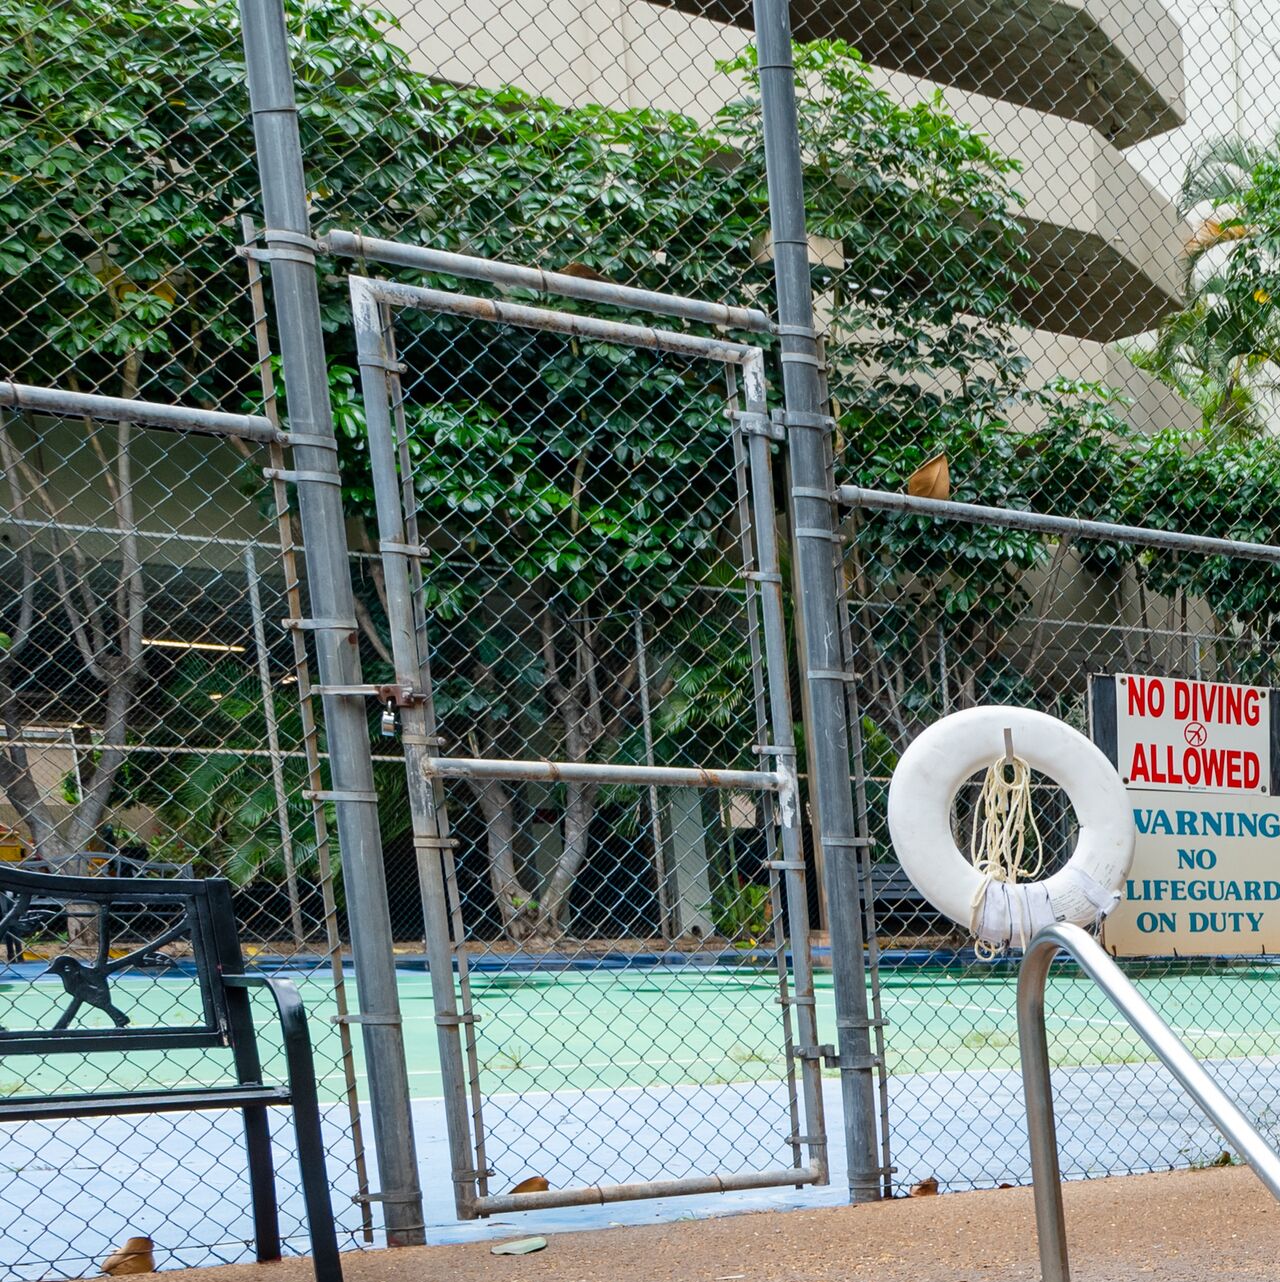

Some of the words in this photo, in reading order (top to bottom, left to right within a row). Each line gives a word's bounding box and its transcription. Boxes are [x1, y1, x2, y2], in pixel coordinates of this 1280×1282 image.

[1128, 675, 1165, 717] NO
[1174, 681, 1260, 726] DIVING
[1130, 742, 1260, 789] ALLOWED
[1177, 848, 1217, 870] NO
[1136, 911, 1177, 933] ON
[1189, 911, 1264, 933] DUTY
